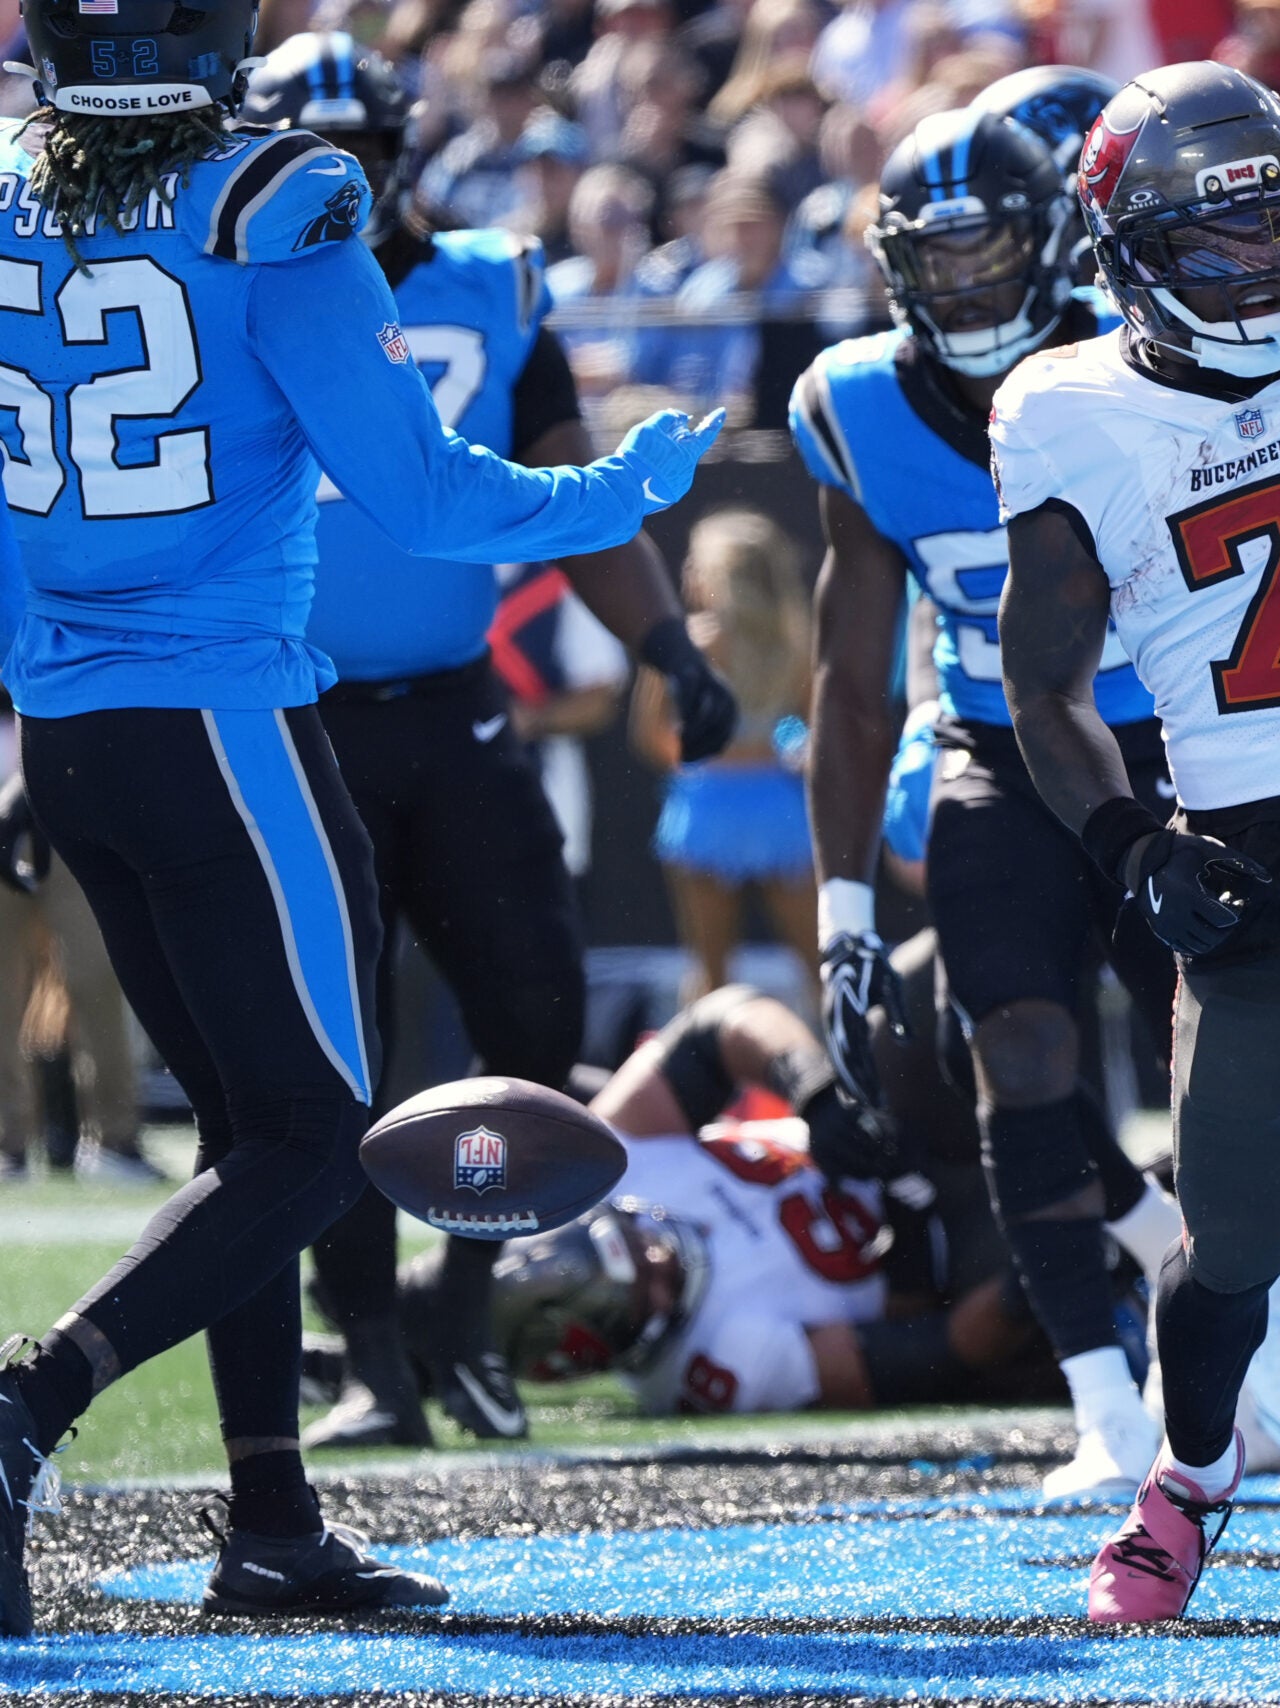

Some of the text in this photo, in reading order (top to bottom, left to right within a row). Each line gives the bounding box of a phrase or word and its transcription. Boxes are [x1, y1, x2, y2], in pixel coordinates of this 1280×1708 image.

[70, 90, 193, 110] CHOOSE LOVE
[0, 253, 216, 521] 52
[1240, 420, 1264, 436] NFL
[460, 1135, 503, 1166] NFL
